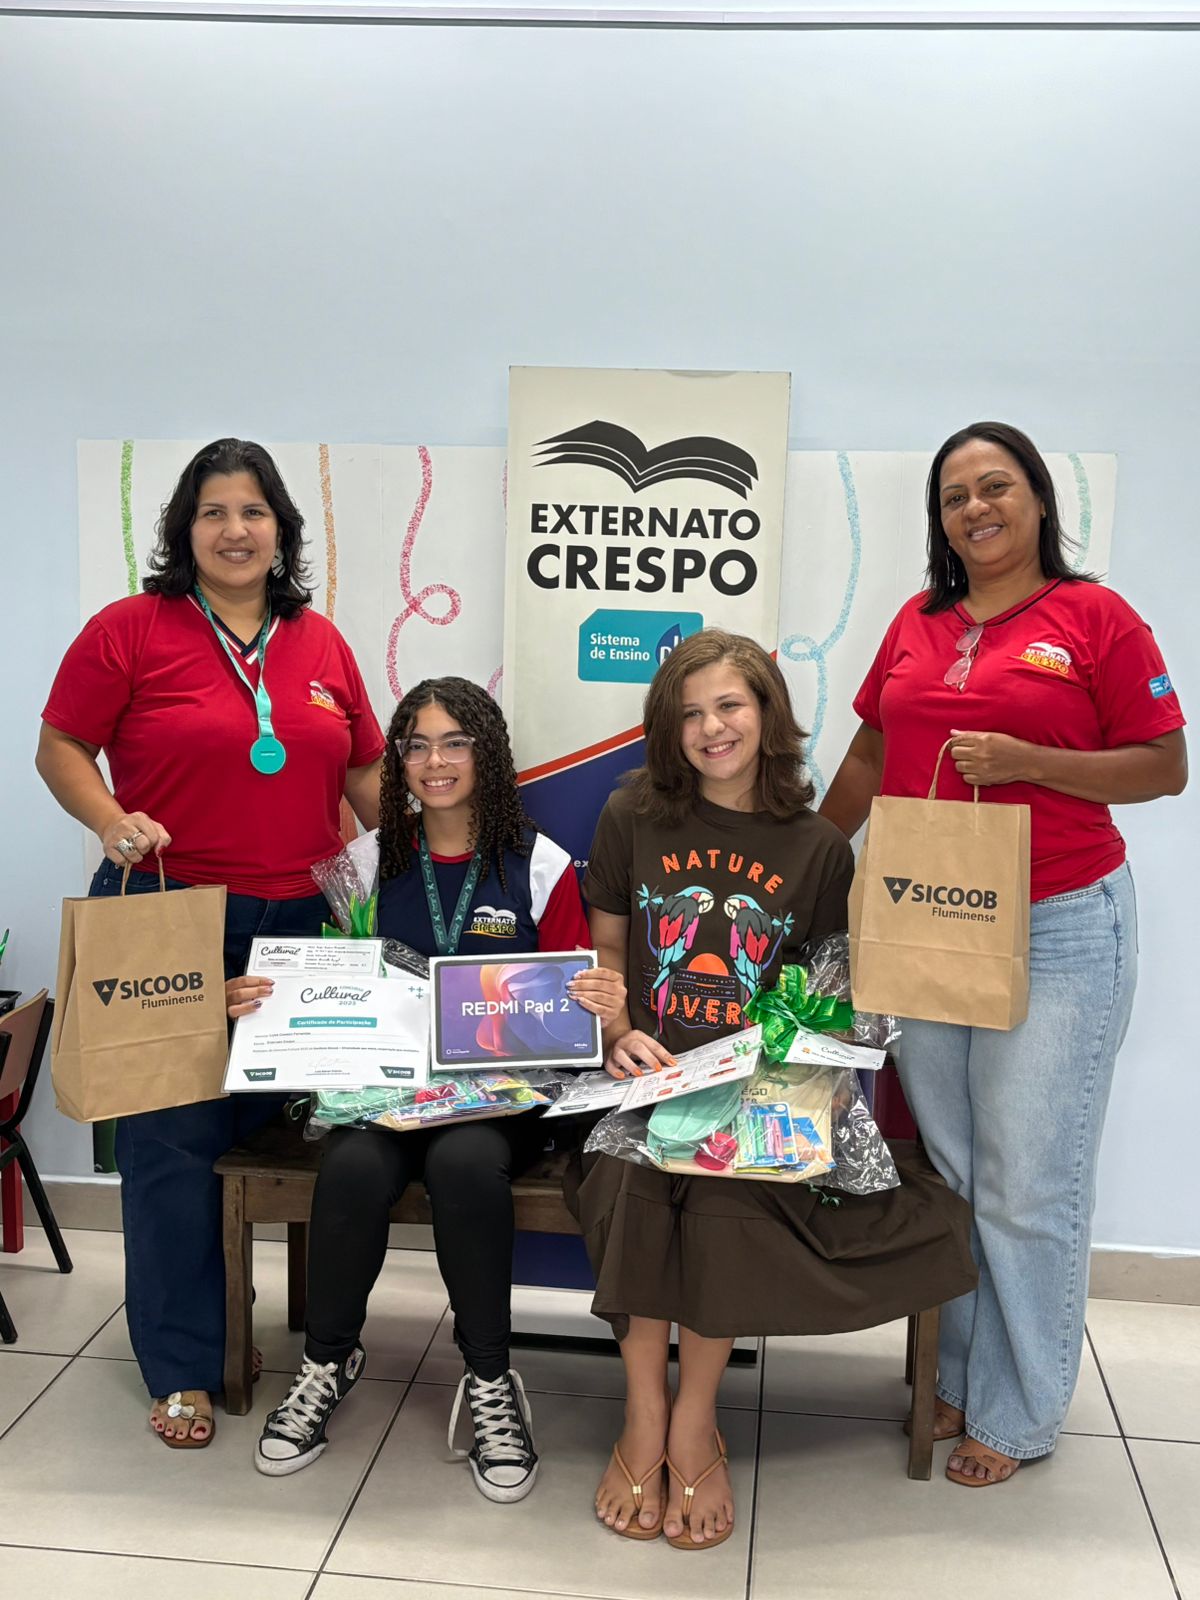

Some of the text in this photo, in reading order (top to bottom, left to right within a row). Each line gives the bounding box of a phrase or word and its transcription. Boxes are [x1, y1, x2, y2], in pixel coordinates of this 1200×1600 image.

[531, 503, 761, 541] EXTERNATO
[527, 543, 758, 597] CRESPO
[590, 633, 640, 646] Sistema
[590, 647, 606, 659] de
[609, 648, 650, 661] Ensino
[661, 849, 784, 894] NATURE
[911, 883, 998, 910] SICOOB
[931, 906, 997, 923] Fluminense
[471, 921, 516, 936] CRESPO
[260, 945, 302, 956] Cultural
[119, 971, 204, 1000] SICOOB
[300, 985, 372, 1004] Cultural
[141, 993, 205, 1010] Fluminense
[461, 998, 570, 1016] REDMI Pad 2
